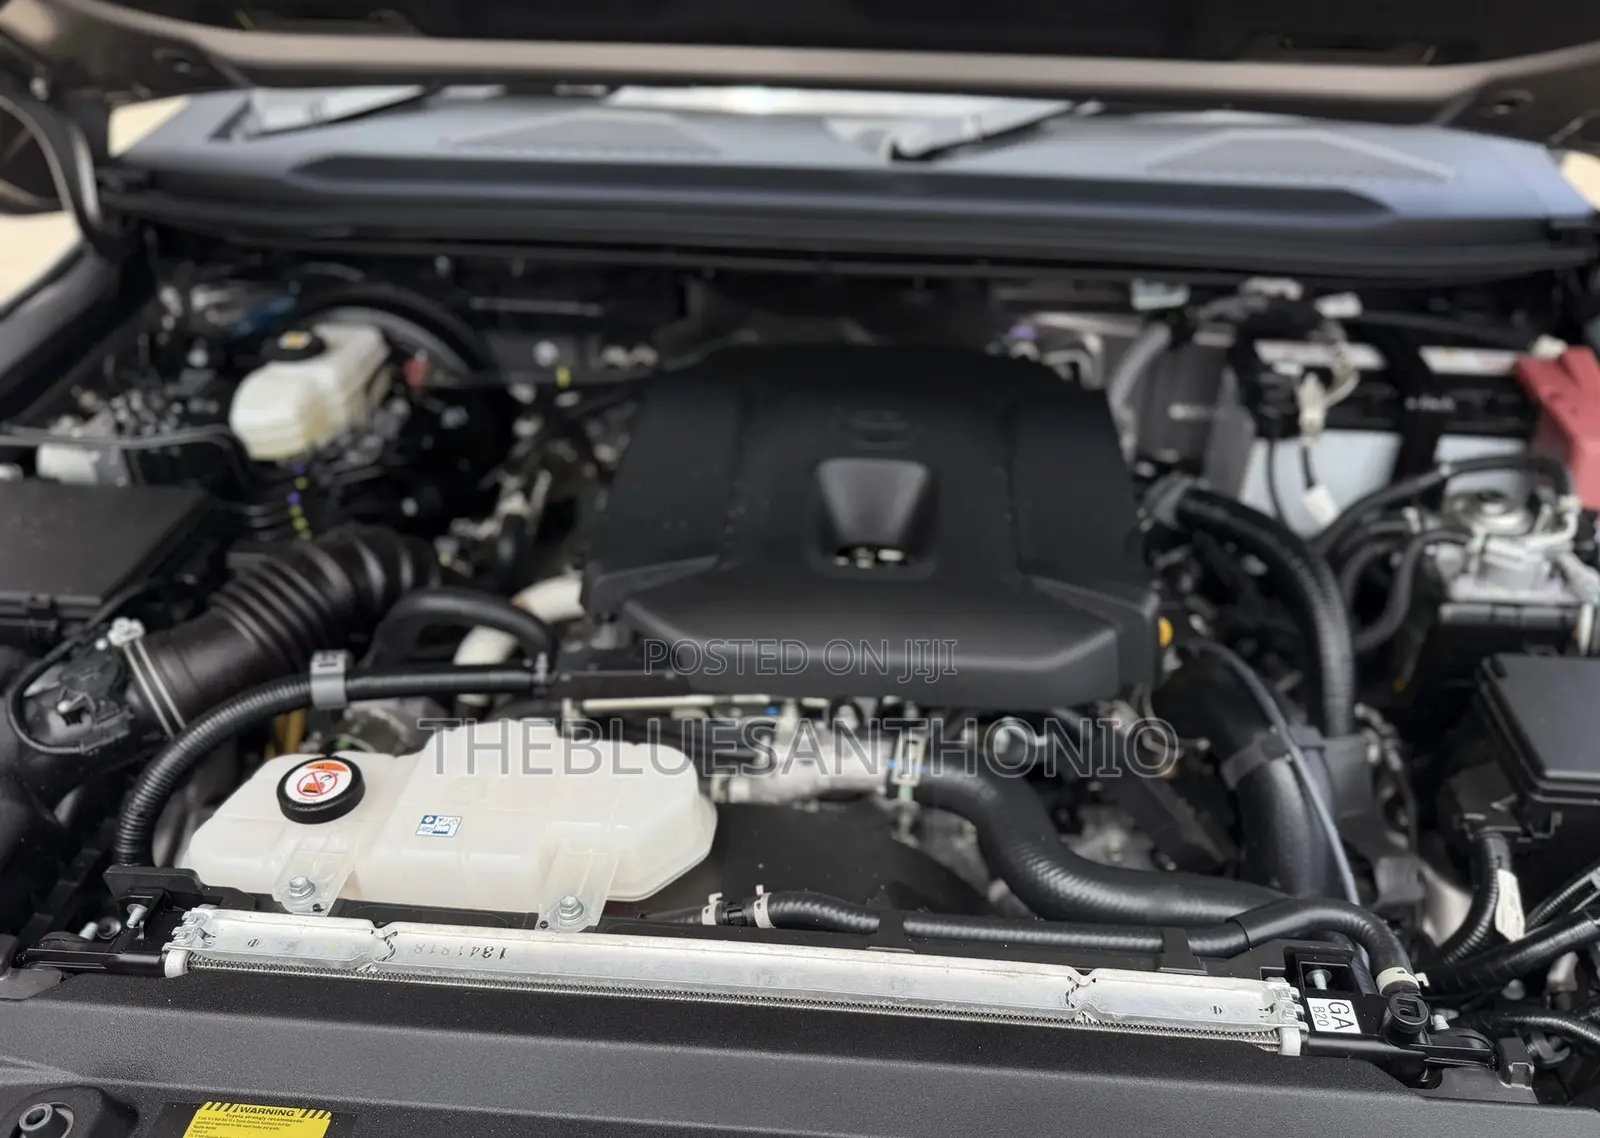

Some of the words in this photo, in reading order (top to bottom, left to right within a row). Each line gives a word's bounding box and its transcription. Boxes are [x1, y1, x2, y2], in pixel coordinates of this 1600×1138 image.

[1312, 1006, 1330, 1027] B20
[1328, 1002, 1355, 1030] GA
[240, 1106, 296, 1117] WARNING
